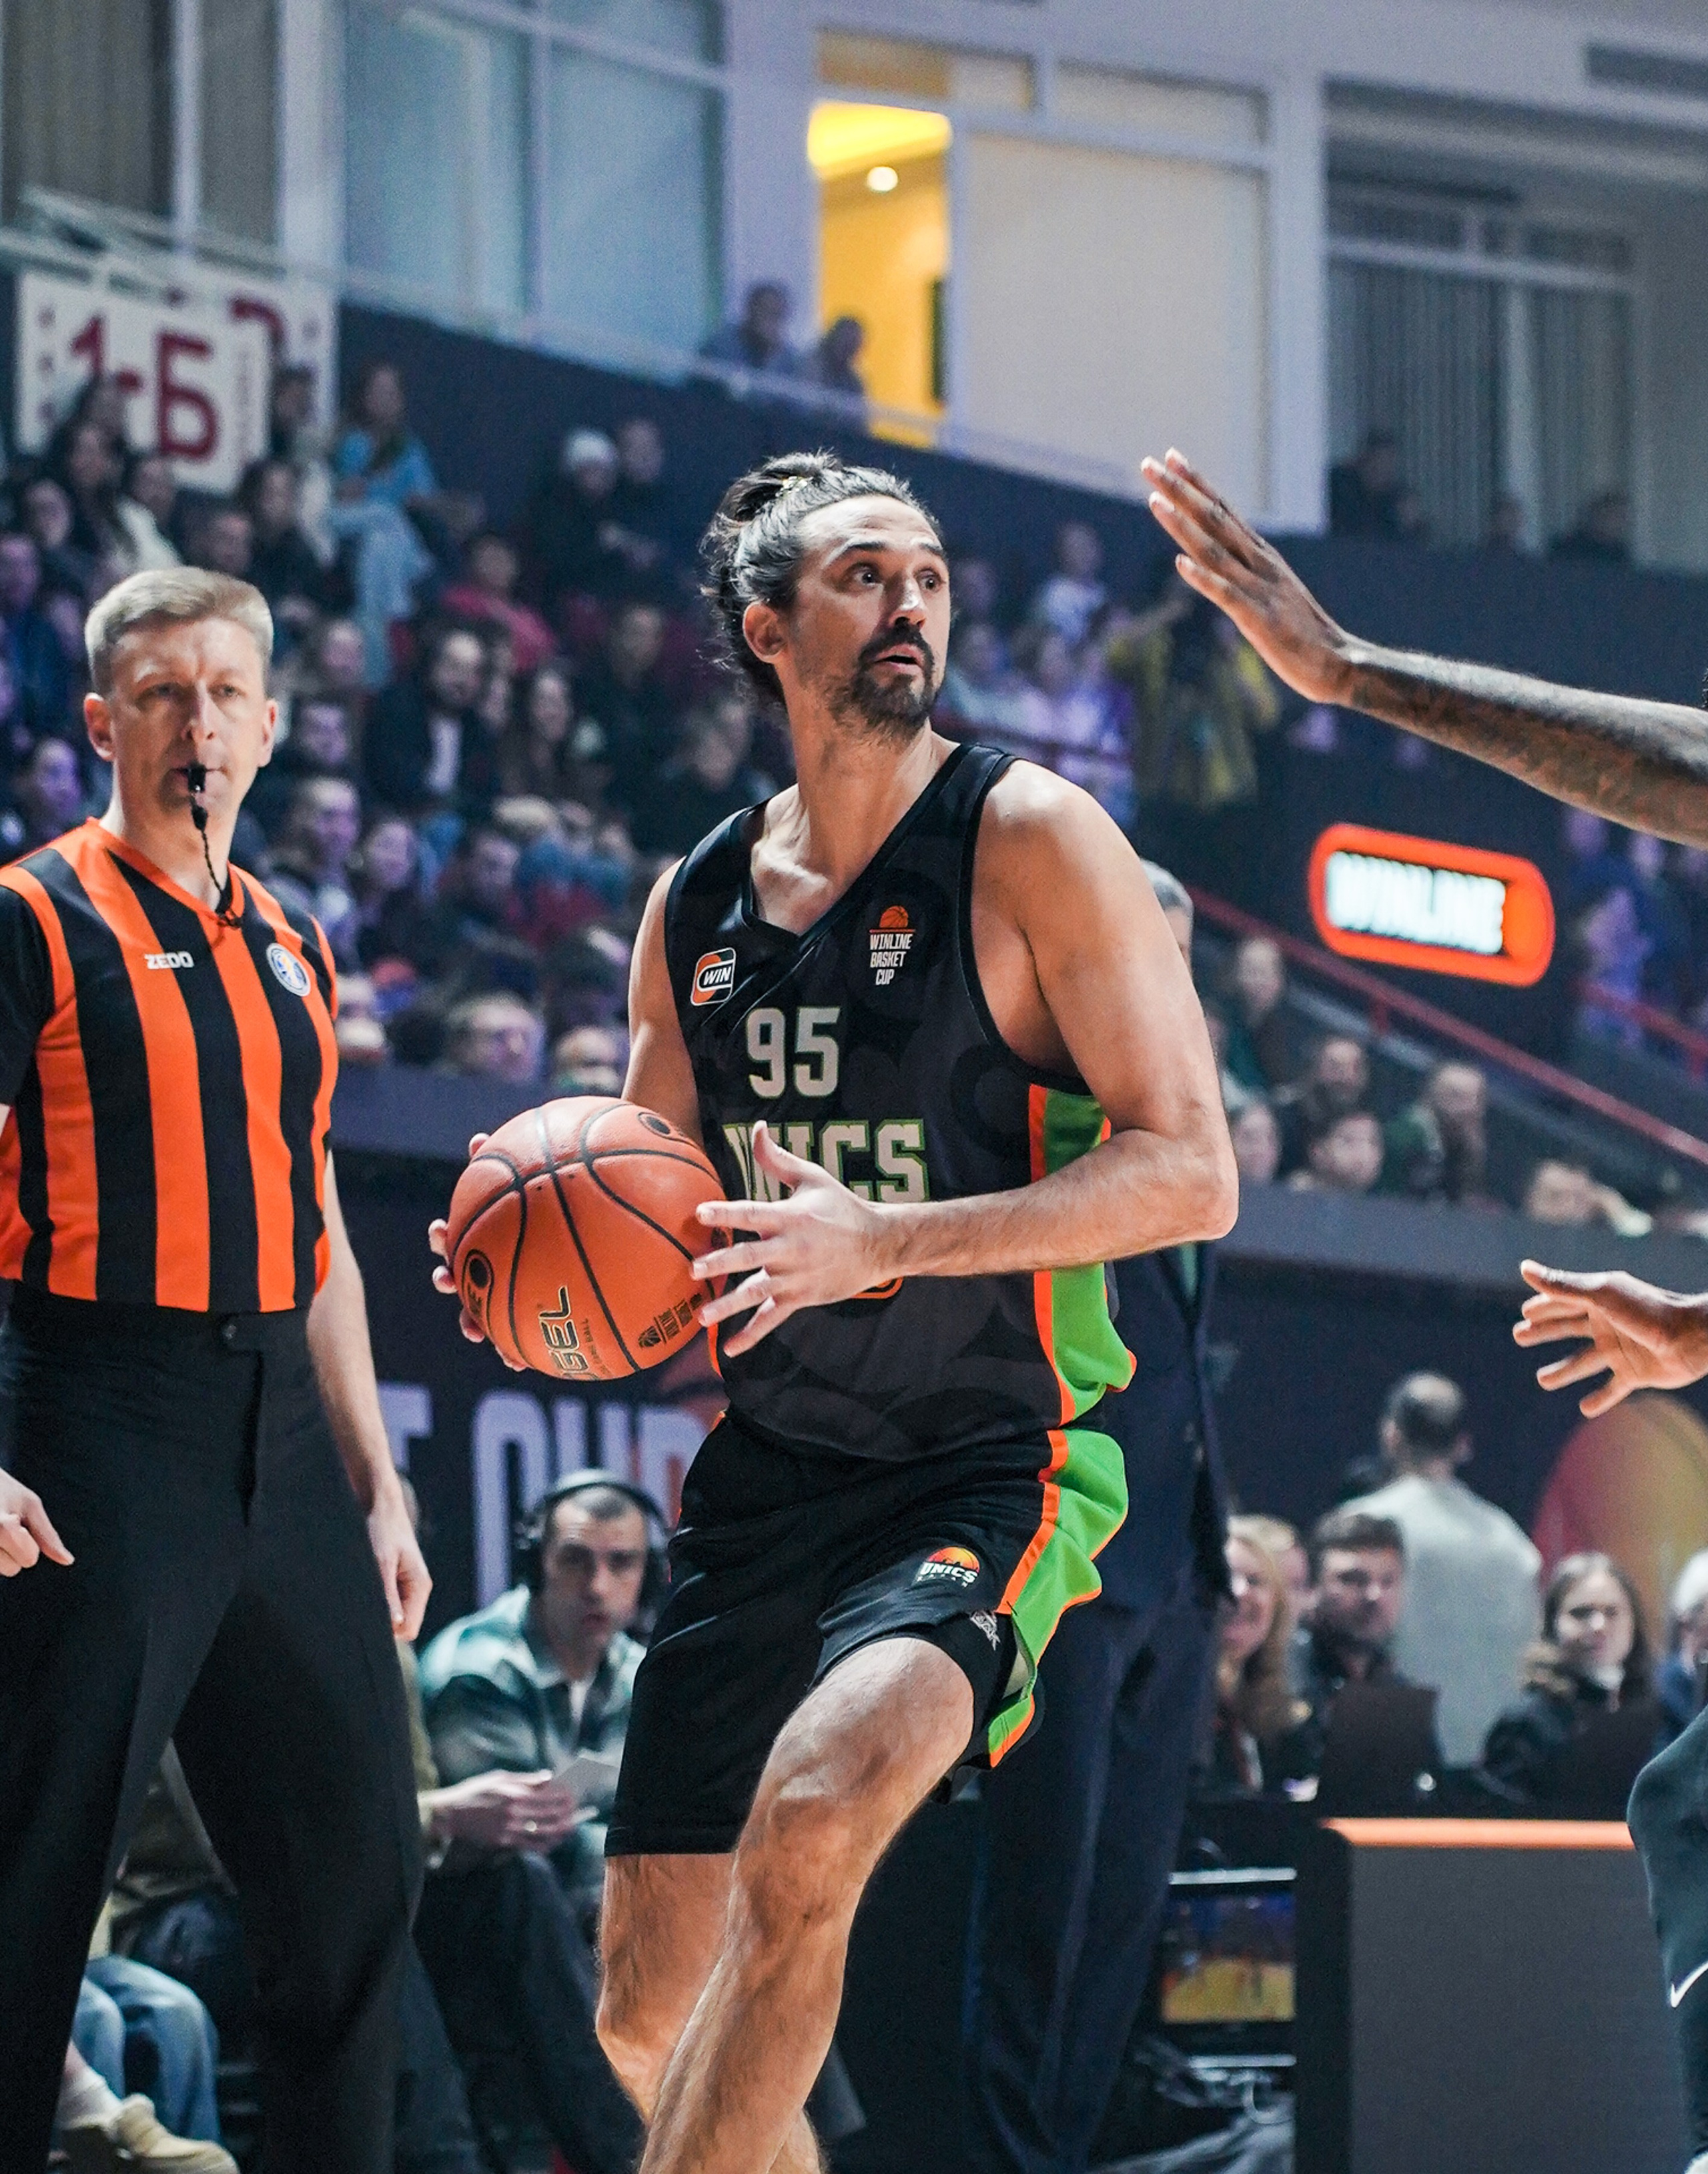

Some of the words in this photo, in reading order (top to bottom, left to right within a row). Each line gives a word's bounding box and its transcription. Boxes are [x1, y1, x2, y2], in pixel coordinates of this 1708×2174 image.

[869, 934, 913, 950] WINLINE
[869, 951, 907, 968] BASKET
[703, 966, 732, 986] WIN
[875, 968, 895, 986] CUP
[747, 1006, 840, 1098] 95
[538, 1285, 598, 1380] GEL
[919, 1561, 978, 1583] UNICS
